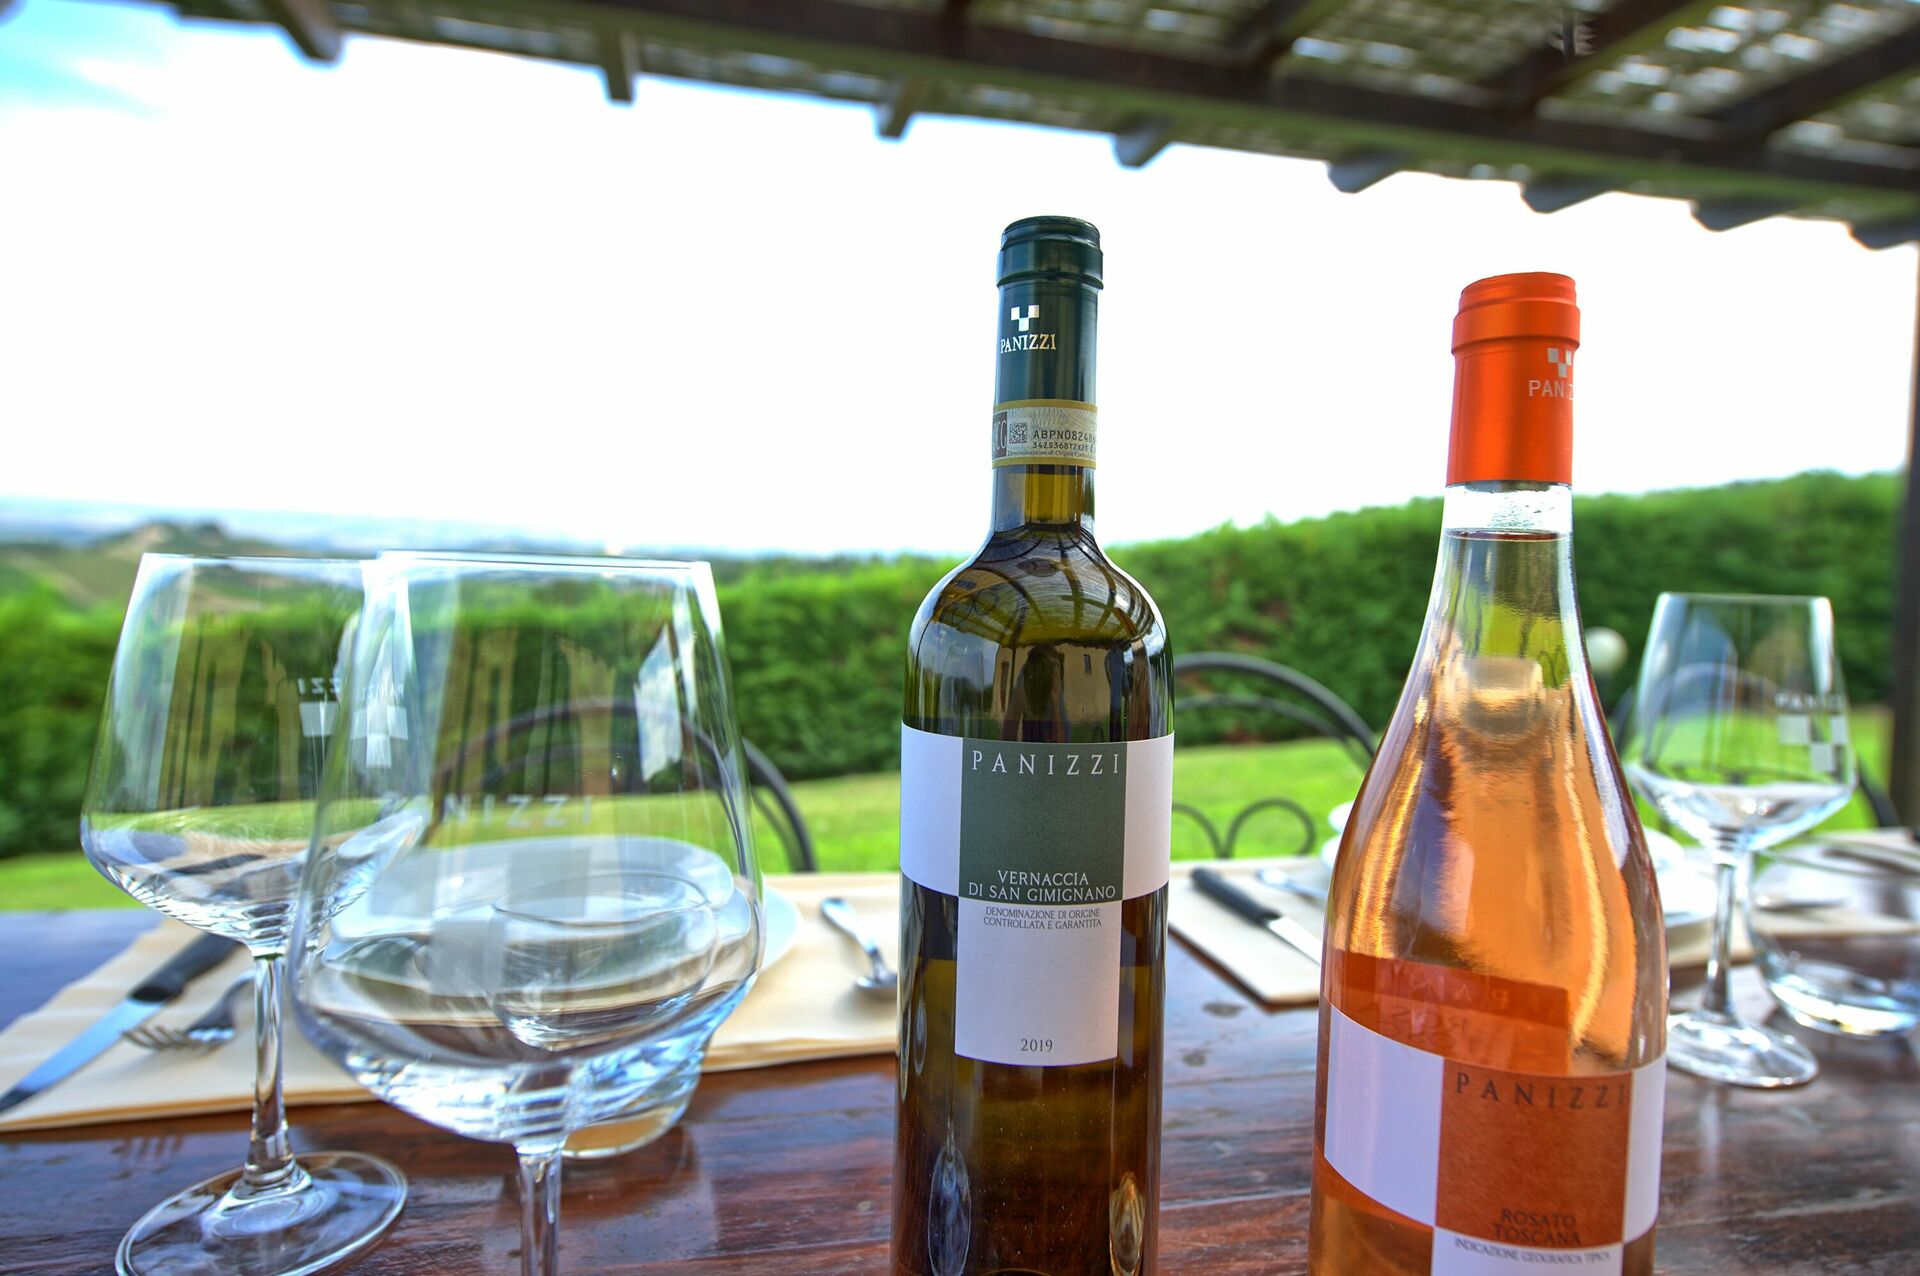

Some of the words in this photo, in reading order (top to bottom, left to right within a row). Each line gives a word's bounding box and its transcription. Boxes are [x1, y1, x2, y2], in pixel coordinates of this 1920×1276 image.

[1000, 333, 1057, 353] PANIZZI
[972, 750, 1119, 775] PANIZZI
[998, 870, 1089, 886] VERNACCIA
[968, 882, 983, 897] DI
[989, 885, 1020, 900] SAN
[1027, 885, 1116, 902] GIMIGNANO
[983, 916, 1045, 930] CONTROLLATA
[1048, 920, 1053, 930] E
[1055, 918, 1102, 930] GARANTITA
[985, 906, 1056, 920] DENOMINAZIONE
[1058, 910, 1067, 919] DI
[1069, 908, 1100, 919] ORIGINE
[1021, 1038, 1053, 1052] 2019
[1455, 1071, 1625, 1109] PANIZZI
[1502, 1208, 1577, 1228] ROSATO
[1491, 1221, 1581, 1246] TOSCANA
